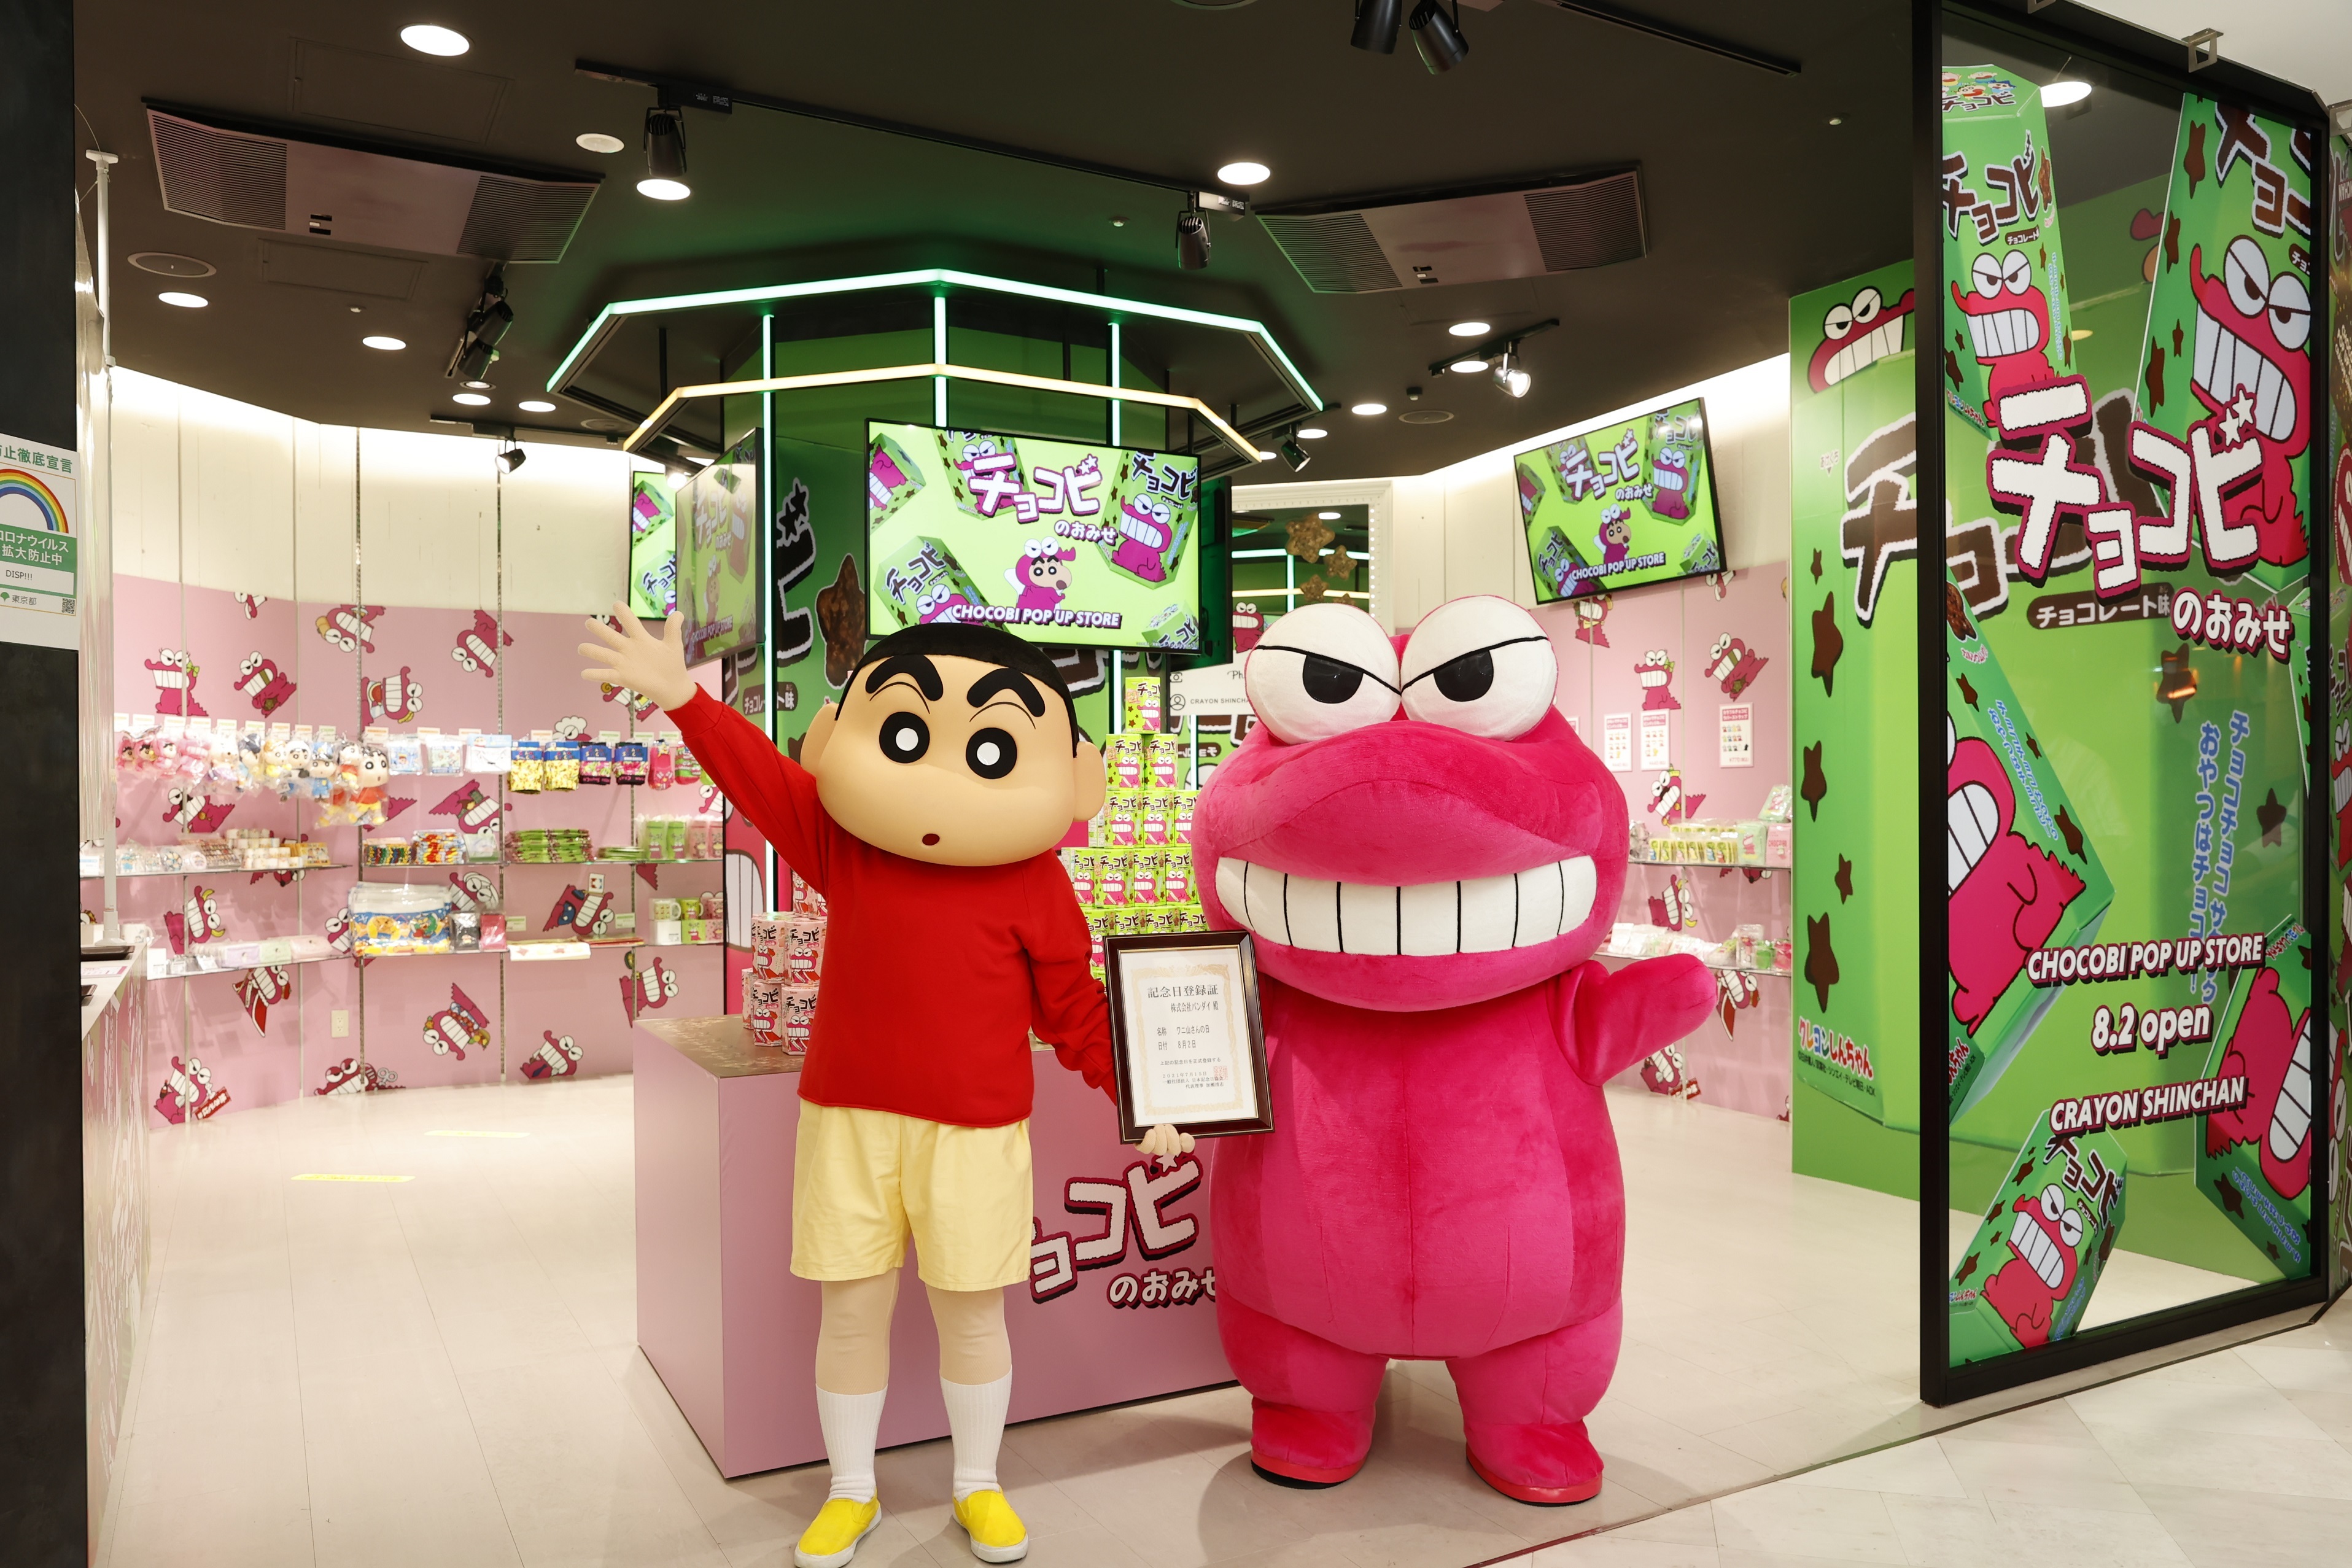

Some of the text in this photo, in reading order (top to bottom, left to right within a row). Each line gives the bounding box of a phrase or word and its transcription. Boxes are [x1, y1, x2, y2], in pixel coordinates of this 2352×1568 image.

[0, 445, 72, 474] 止徹底宣言
[1566, 429, 1640, 500] チョコビ
[968, 454, 1103, 524] チョコビ
[1615, 483, 1653, 502] のおみせ
[1988, 376, 2265, 594] チョコビ
[1054, 519, 1118, 545] のおみせ
[2, 544, 63, 565] 拡大防止中
[1572, 553, 1665, 580] CHOCOBI POP UP STORE
[6, 570, 33, 581] DISP!!!
[885, 541, 948, 605] チョコビ
[12, 595, 37, 605] 東京都
[952, 604, 1120, 627] CHOCOBI POP UP STORE
[2172, 588, 2292, 657] のおみせ
[743, 690, 795, 714] チョコレト味
[1100, 853, 1128, 871] チョコビ
[1146, 912, 1173, 929] チョコビ
[789, 926, 820, 945] チョコビ
[2028, 934, 2264, 980] CHOCOBI POP UP STORE
[1147, 984, 1219, 998] 記念日登録証
[1171, 1001, 1219, 1012] 株式会社バンダイ 殿
[1157, 1025, 1209, 1036] 名称 ワニ山さんの日
[2092, 1004, 2211, 1052] 8.2 open
[1158, 1041, 1168, 1050] 日付
[1798, 1016, 1874, 1081] クレヨンしんちゃん
[1160, 1057, 1221, 1066] 上記の記念日を正式登録する
[2050, 1076, 2245, 1131] CRAYON SHINCHAN
[1030, 1149, 1203, 1303] ョコビ
